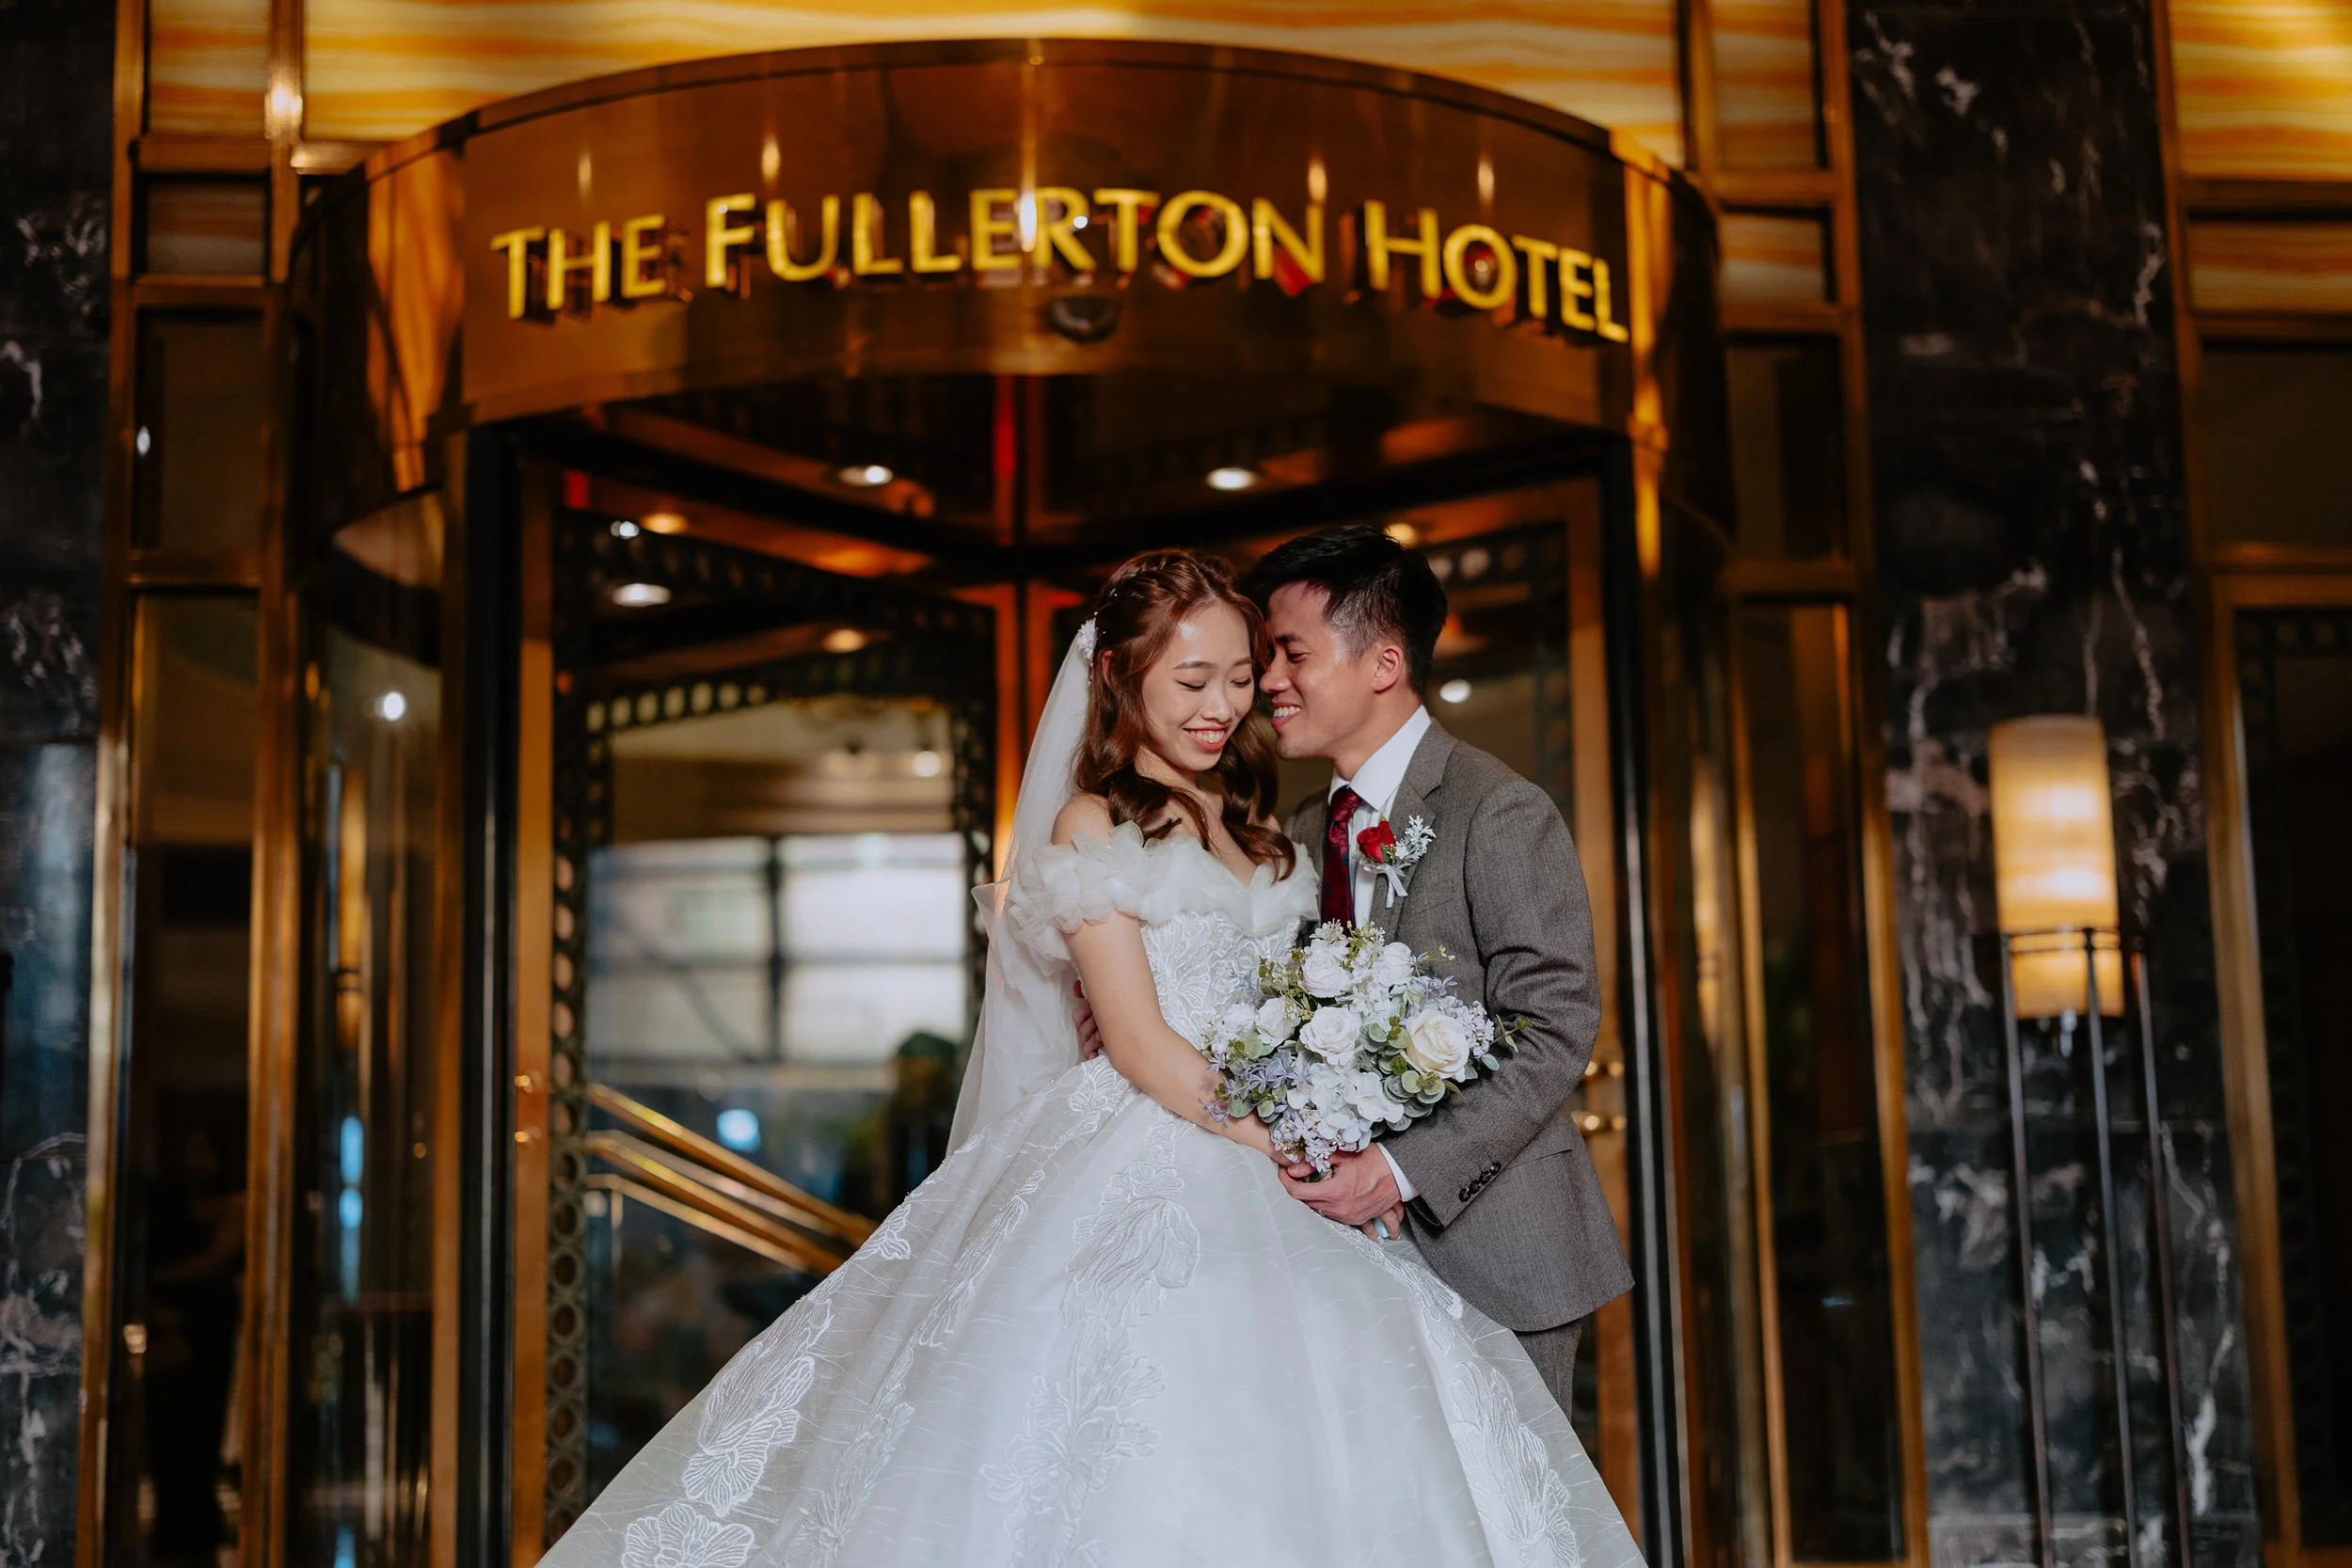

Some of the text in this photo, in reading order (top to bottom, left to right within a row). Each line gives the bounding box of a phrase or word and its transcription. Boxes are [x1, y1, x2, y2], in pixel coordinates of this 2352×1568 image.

[490, 187, 1629, 343] THE FULLERTON HOTEL
